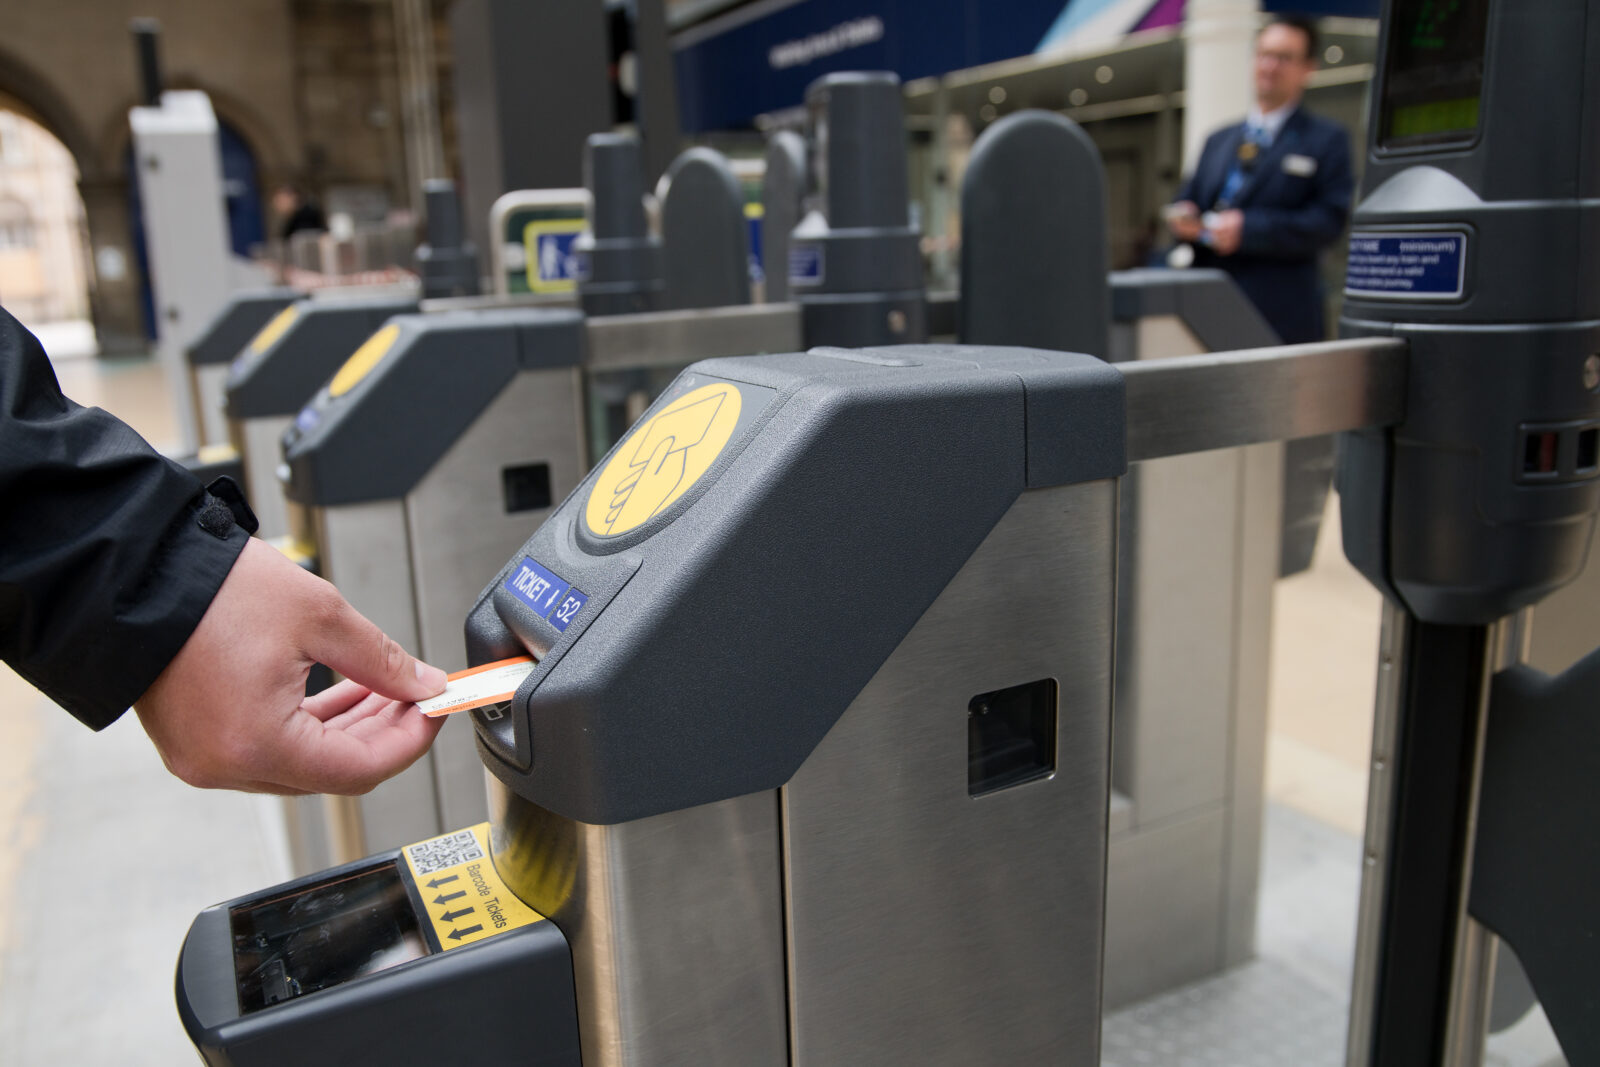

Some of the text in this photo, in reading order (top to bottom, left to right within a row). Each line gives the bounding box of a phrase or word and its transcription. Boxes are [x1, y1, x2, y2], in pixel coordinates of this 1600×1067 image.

[1399, 240, 1456, 253] (minimum)
[1421, 253, 1440, 264] and
[513, 566, 581, 624] TICKET 52
[466, 864, 507, 929] Barcode Tickets
